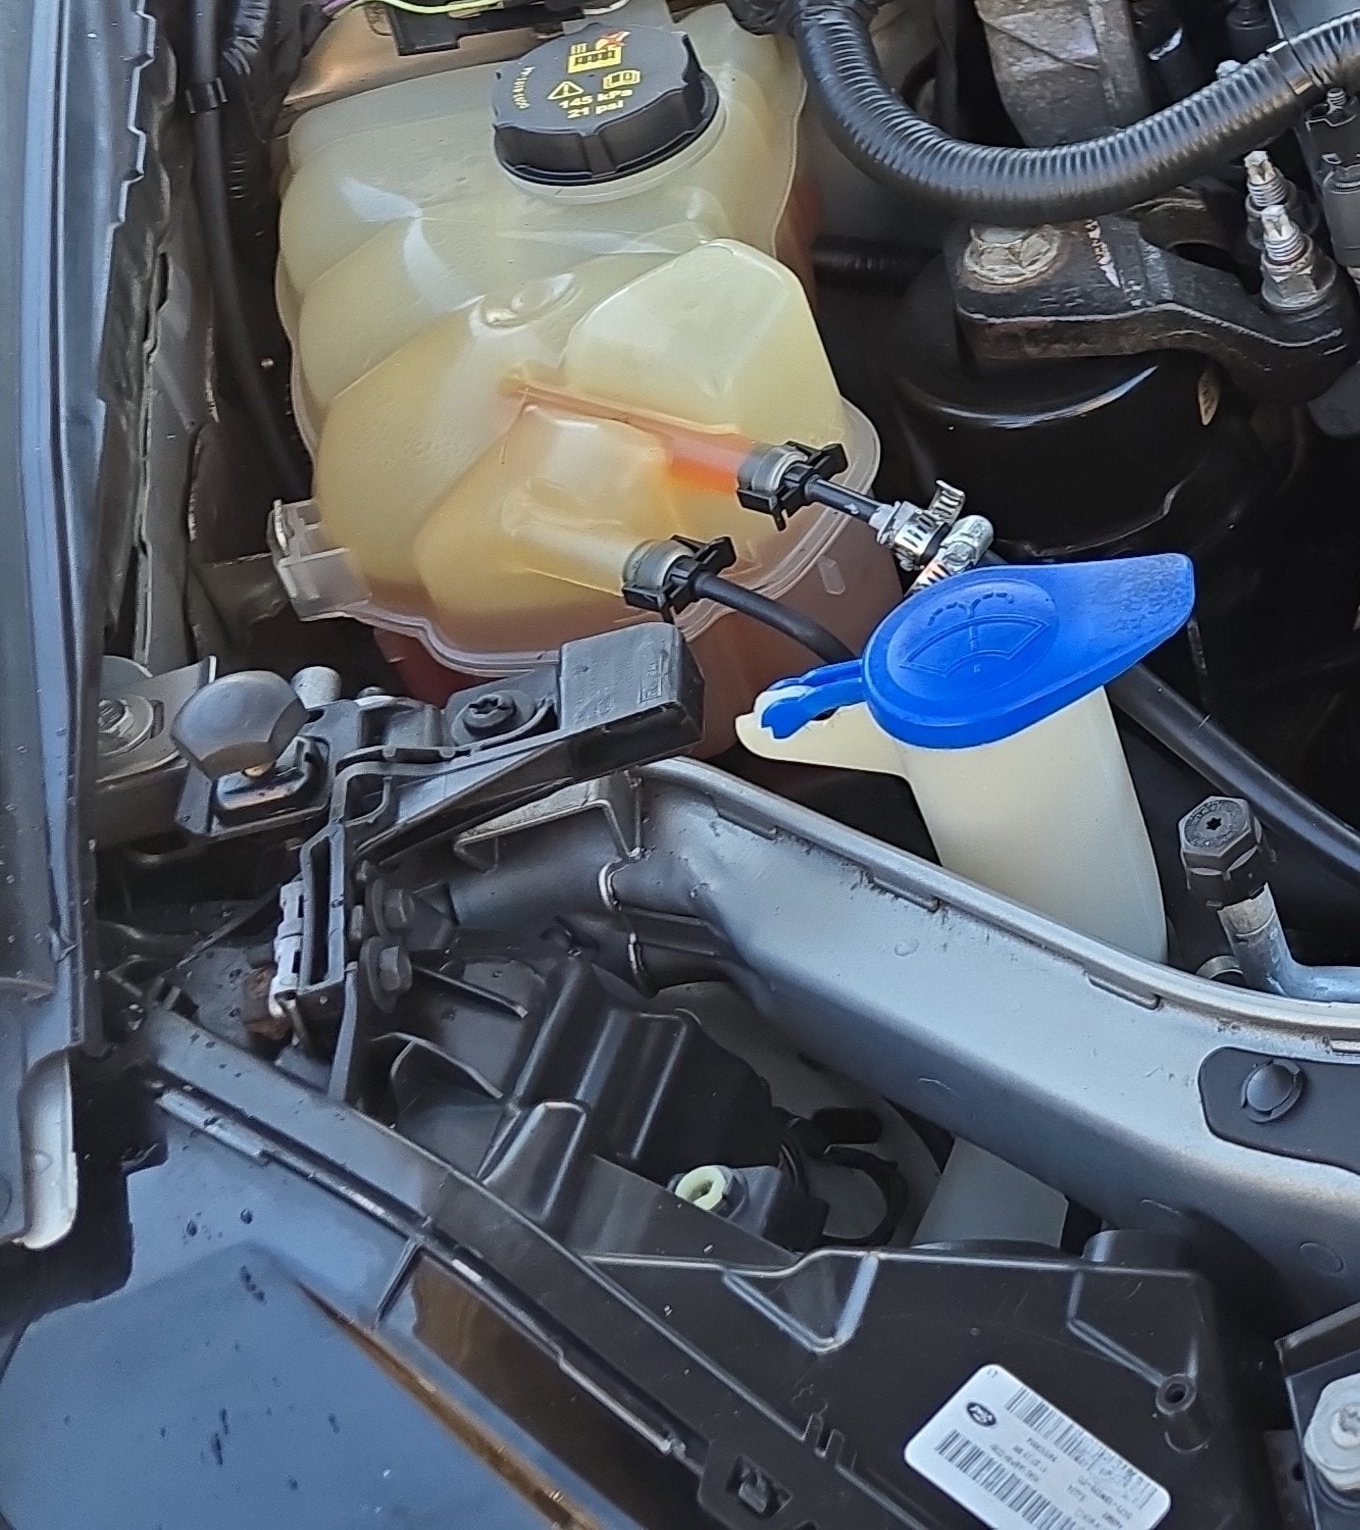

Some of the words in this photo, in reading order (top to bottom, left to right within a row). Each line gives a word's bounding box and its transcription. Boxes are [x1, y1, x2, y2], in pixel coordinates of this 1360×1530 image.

[559, 95, 593, 109] 145
[567, 106, 590, 119] 21
[595, 99, 625, 115] psi
